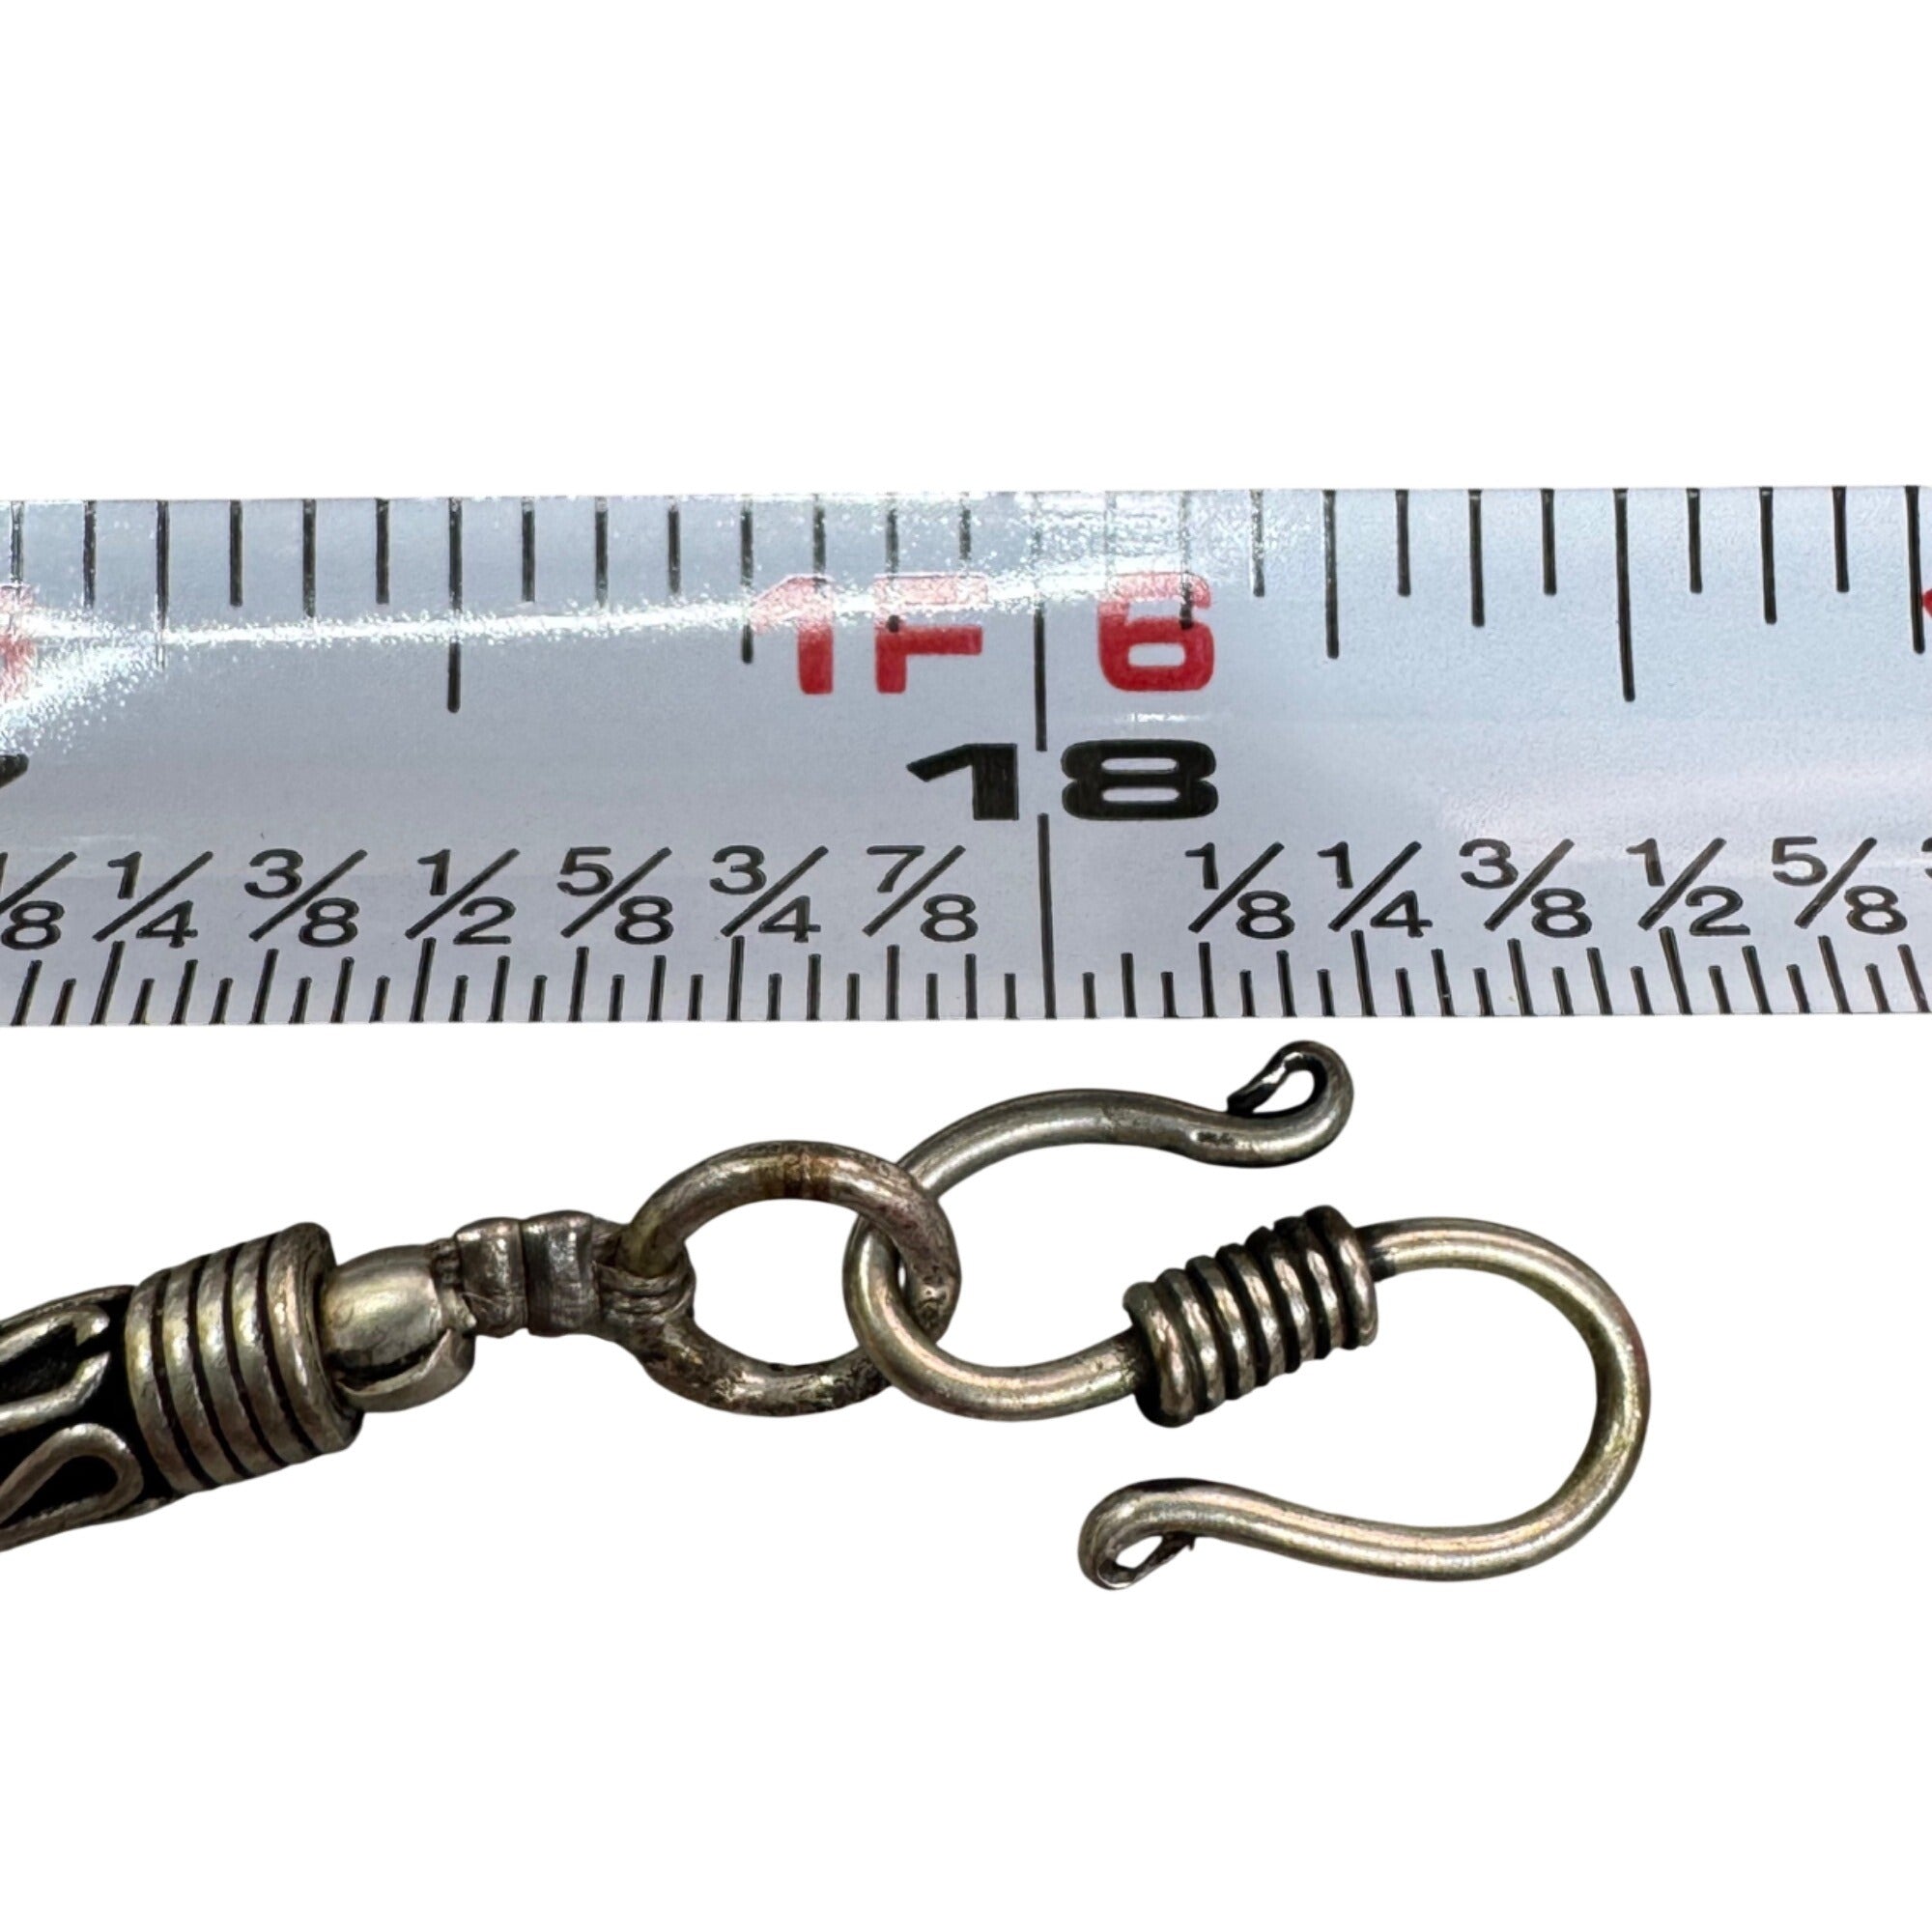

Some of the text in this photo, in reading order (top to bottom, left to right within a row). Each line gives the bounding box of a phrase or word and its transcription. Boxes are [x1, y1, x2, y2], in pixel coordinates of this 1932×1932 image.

[1097, 571, 1215, 693] 6
[905, 738, 1219, 822] 18
[0, 851, 77, 951] /8
[93, 851, 213, 949] 1/4
[243, 848, 368, 948] 3/8
[404, 848, 521, 946] 1/2
[556, 846, 674, 946] 5/8
[709, 845, 829, 944] 3/4
[862, 845, 979, 943] 7/8
[1185, 841, 1295, 940] 1/8
[1317, 840, 1434, 938] 1/4
[1459, 838, 1593, 939] 3/8
[1625, 838, 1750, 937] 1/2
[1772, 837, 1909, 935] 5/8
